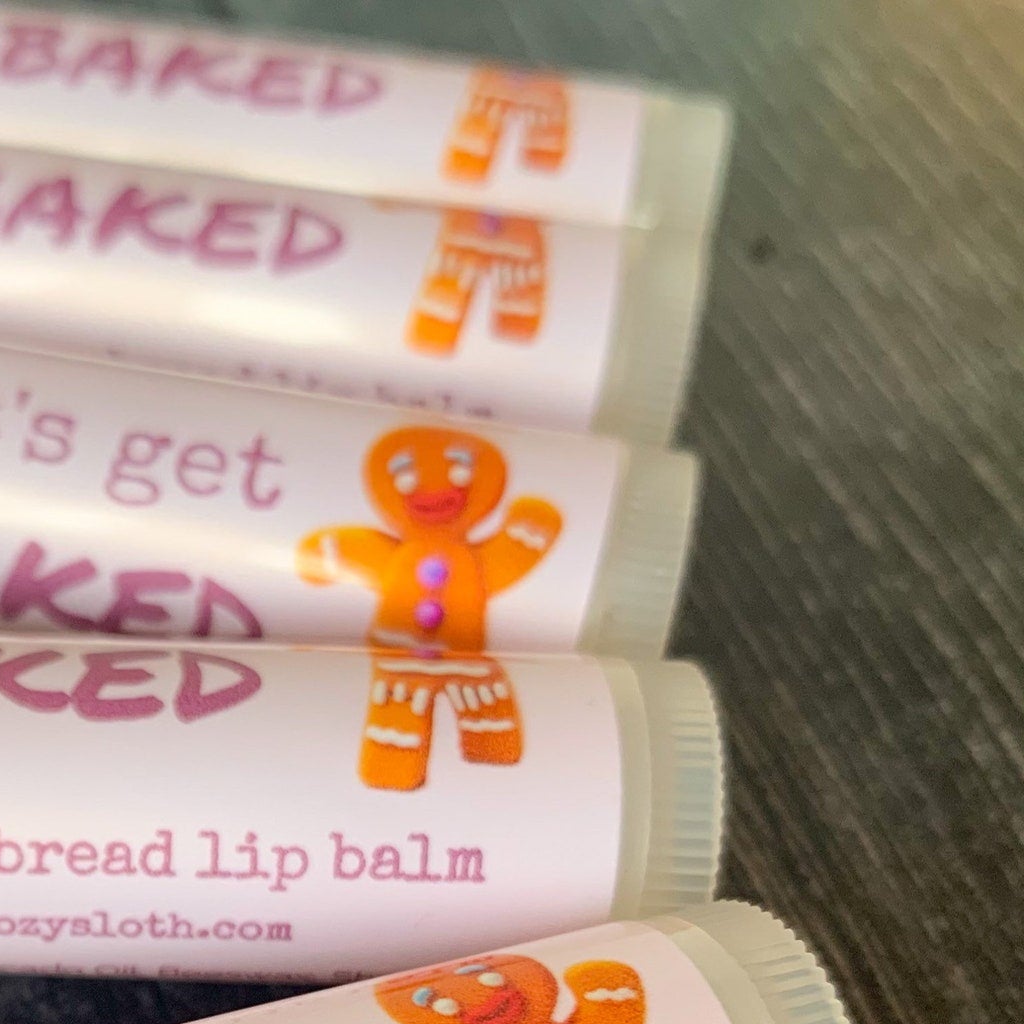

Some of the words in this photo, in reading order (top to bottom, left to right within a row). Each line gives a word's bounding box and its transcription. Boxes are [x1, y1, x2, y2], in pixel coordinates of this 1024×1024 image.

[104, 429, 283, 511] get
[195, 829, 309, 892] lip
[329, 832, 486, 883] balm
